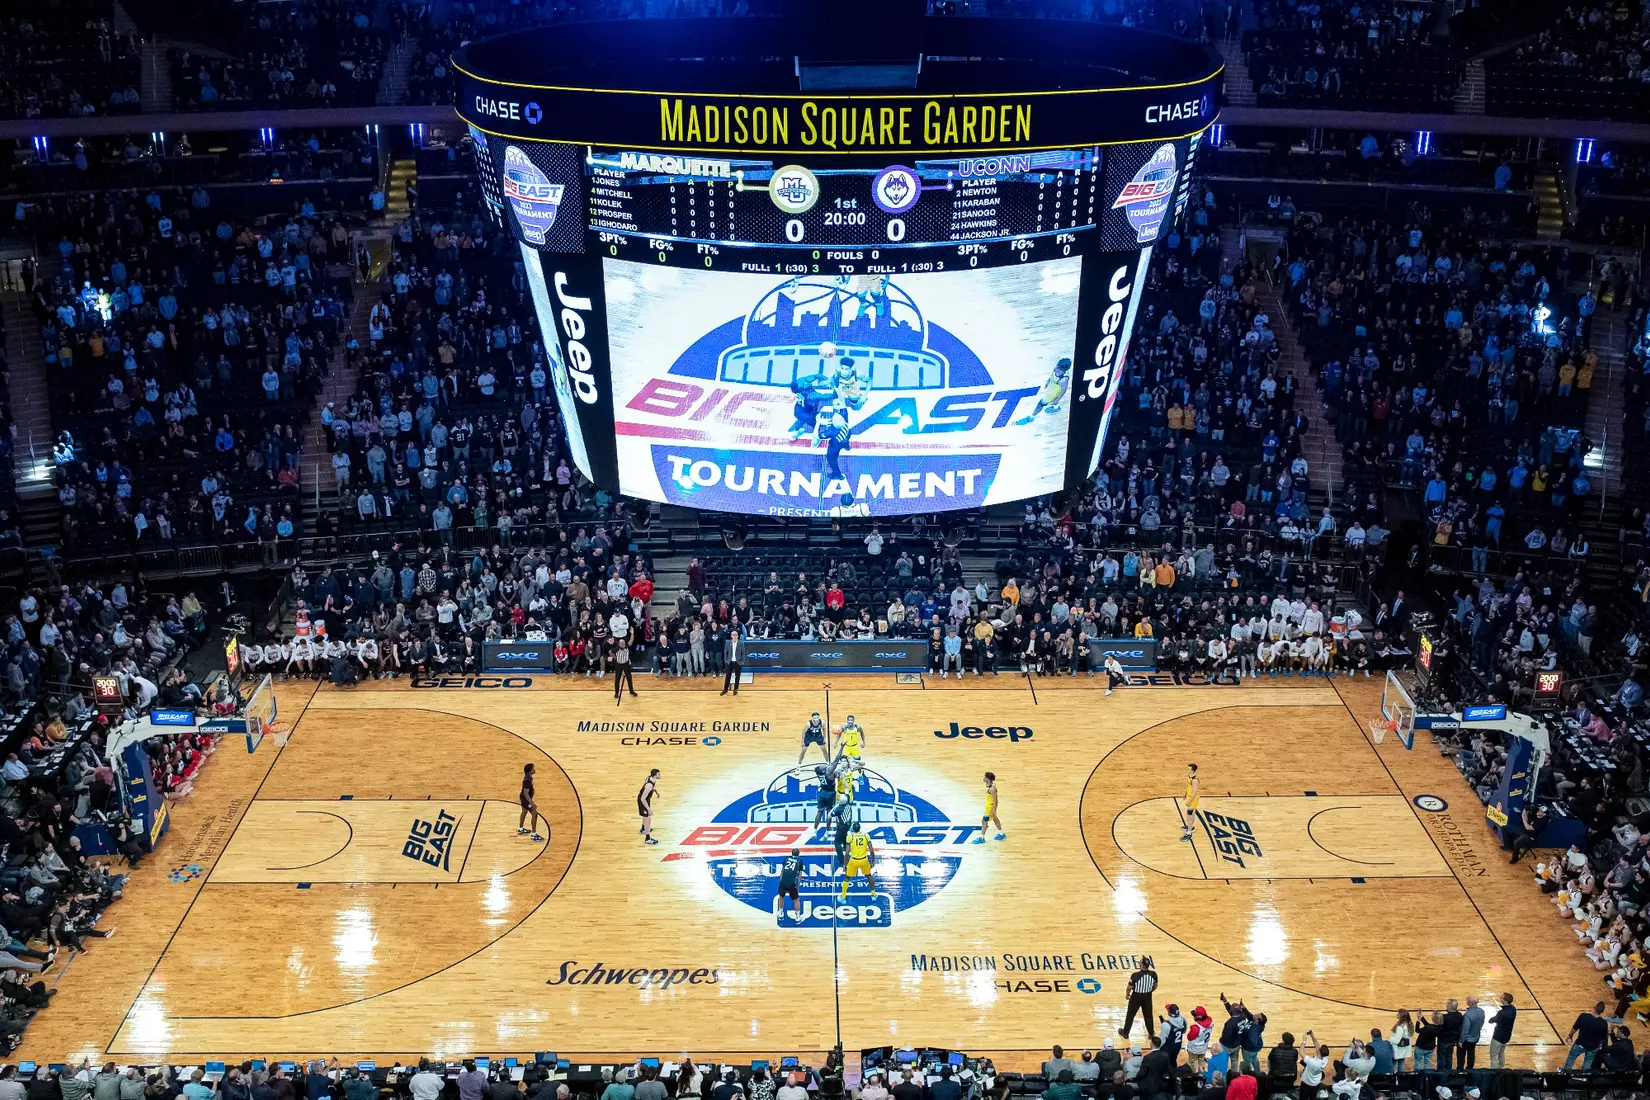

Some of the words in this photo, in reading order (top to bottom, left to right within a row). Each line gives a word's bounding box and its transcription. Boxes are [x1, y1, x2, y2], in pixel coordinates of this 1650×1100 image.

[475, 95, 521, 120] CHASE
[1146, 99, 1200, 123] CHASE
[661, 98, 788, 145] MADISON
[801, 102, 912, 149] SQUARE
[924, 101, 1031, 145] GARDEN
[620, 152, 731, 178] MARQUETTE
[958, 155, 1031, 177] UCONN
[594, 168, 625, 179] PLAYER
[962, 178, 996, 187] PLAYER
[1040, 173, 1046, 181] F
[1057, 171, 1063, 179] A
[1092, 166, 1098, 174] P
[595, 177, 620, 187] JONES
[518, 184, 560, 198] EAST
[596, 188, 633, 199] MITCHELL
[956, 190, 961, 198] 2
[962, 187, 997, 197] NEWTON
[1122, 183, 1156, 197] BIG
[590, 197, 597, 205] 11
[597, 198, 623, 209] KOLEK
[834, 197, 857, 209] 1st
[962, 198, 1000, 208] KARABAN
[589, 208, 597, 216] 12
[598, 208, 633, 220] PROSPER
[824, 212, 866, 226] 20:00
[961, 209, 996, 219] SANOGO
[590, 218, 598, 226] 13
[598, 219, 638, 231] IGHODARO
[785, 219, 804, 242] 0
[887, 218, 905, 241] 0
[951, 222, 960, 230] 24
[961, 219, 997, 229] HAWKINS
[523, 226, 542, 241] Jeep
[599, 231, 627, 245] 3PT%
[961, 230, 998, 240] JACKSON
[998, 229, 1011, 237] JR.
[1056, 233, 1076, 245] FT%
[610, 245, 617, 256] 0
[650, 238, 674, 251] FG%
[697, 243, 719, 255] FT%
[957, 243, 988, 255] 3PT%
[1011, 239, 1034, 250] FG%
[1063, 244, 1070, 256] 0
[659, 251, 666, 262] 0
[704, 256, 712, 267] 0
[812, 250, 820, 260] 0
[827, 250, 864, 260] FOULS
[871, 250, 880, 259] 0
[970, 255, 978, 267] 0
[1020, 250, 1028, 262] 0
[741, 262, 771, 272] FULL:
[775, 263, 781, 272] 1
[785, 263, 808, 273] (:30)
[812, 264, 820, 273] 3
[839, 265, 854, 273] TO
[867, 265, 896, 273] FULL:
[901, 263, 907, 271] 1
[911, 261, 933, 272] (:30)
[936, 261, 944, 270] 3
[554, 271, 598, 405] Jeep
[1082, 265, 1131, 399] Jeep
[625, 378, 797, 430] BIG
[456, 433, 465, 442] 21
[667, 455, 982, 500] TOURNAMENT
[769, 506, 831, 518] PRESENT
[411, 677, 533, 688] GEICO
[1127, 675, 1241, 685] GEICO
[1542, 681, 1554, 691] 30
[102, 686, 114, 696] 30
[577, 720, 645, 732] MADISON
[650, 720, 707, 733] SQUARE
[712, 720, 770, 732] GARDEN
[933, 722, 1034, 742] Jeep
[621, 737, 698, 746] CHASE
[196, 823, 228, 862] Meridian
[219, 798, 243, 824] Health
[680, 826, 808, 846] BIG
[1225, 816, 1263, 857] BIG
[178, 814, 217, 862] Hackensack
[402, 818, 433, 861] BIG
[422, 808, 456, 867] EAST
[856, 837, 864, 846] 12
[1203, 810, 1246, 869] EAST
[1437, 813, 1491, 877] ROTHMAN
[717, 863, 950, 877] TOURNAEN
[784, 861, 796, 871] 24
[787, 901, 881, 924] Jeep
[911, 954, 997, 972] MADISON
[1004, 953, 1076, 972] SQUARE
[546, 961, 719, 990] Schweppes
[993, 980, 1072, 993] HASE
[1174, 1031, 1182, 1044] 2
[1204, 1031, 1210, 1043] 2
